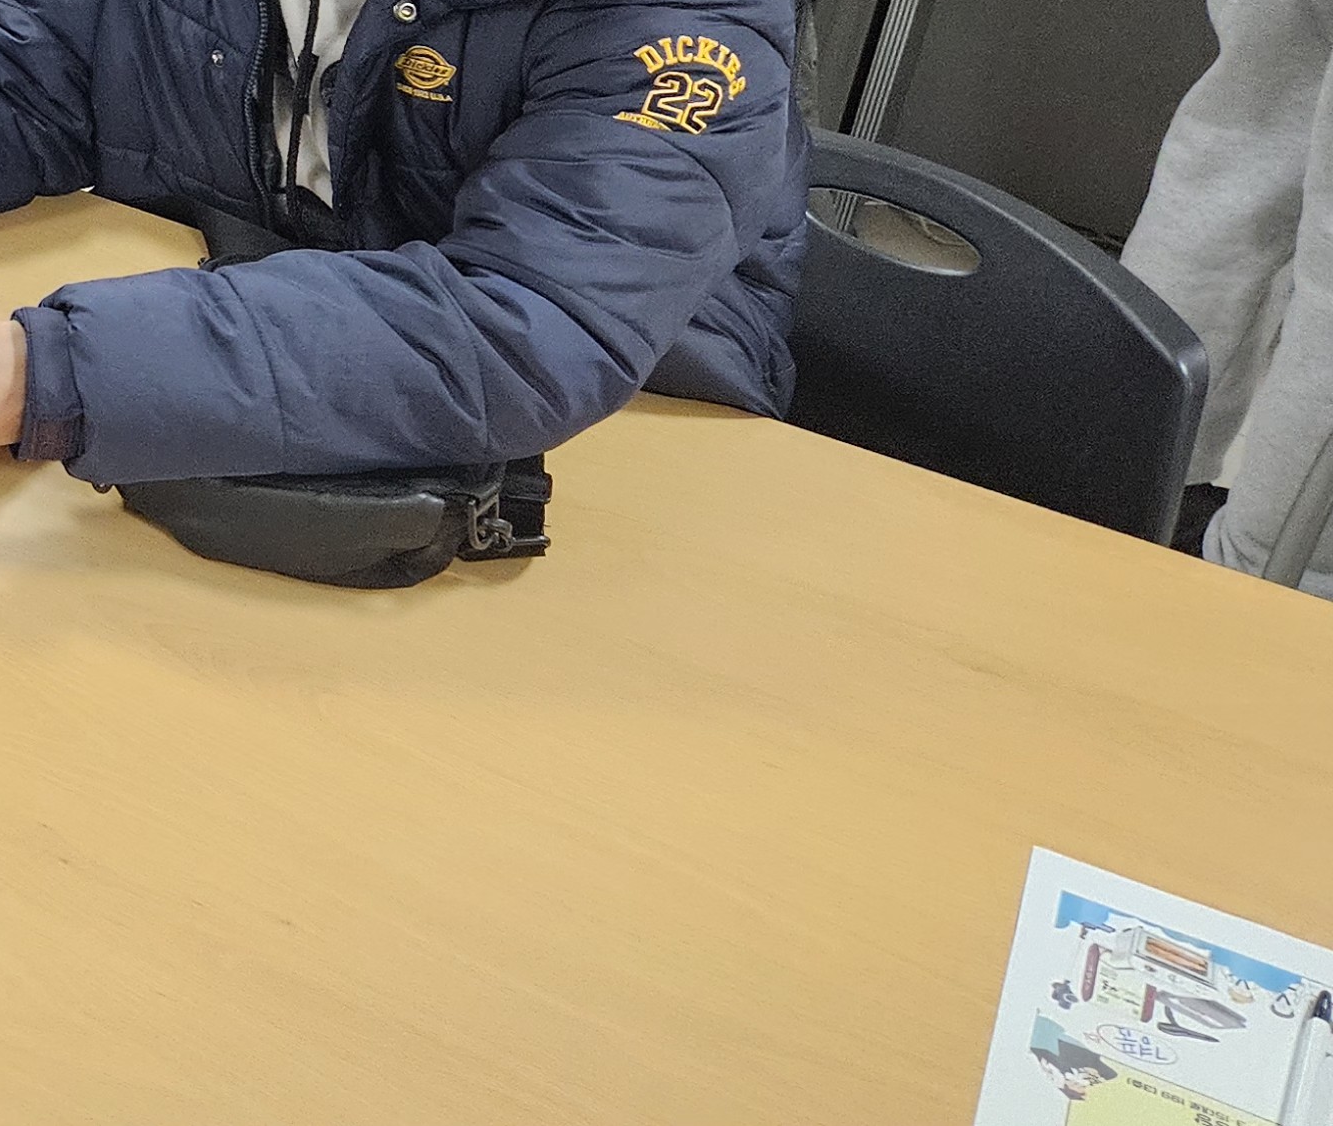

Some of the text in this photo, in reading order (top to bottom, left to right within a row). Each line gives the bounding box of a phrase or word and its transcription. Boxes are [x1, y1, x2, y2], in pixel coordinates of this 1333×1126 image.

[633, 35, 747, 101] DICKIES
[641, 71, 724, 135] 22
[1162, 1090, 1185, 1106] 199
